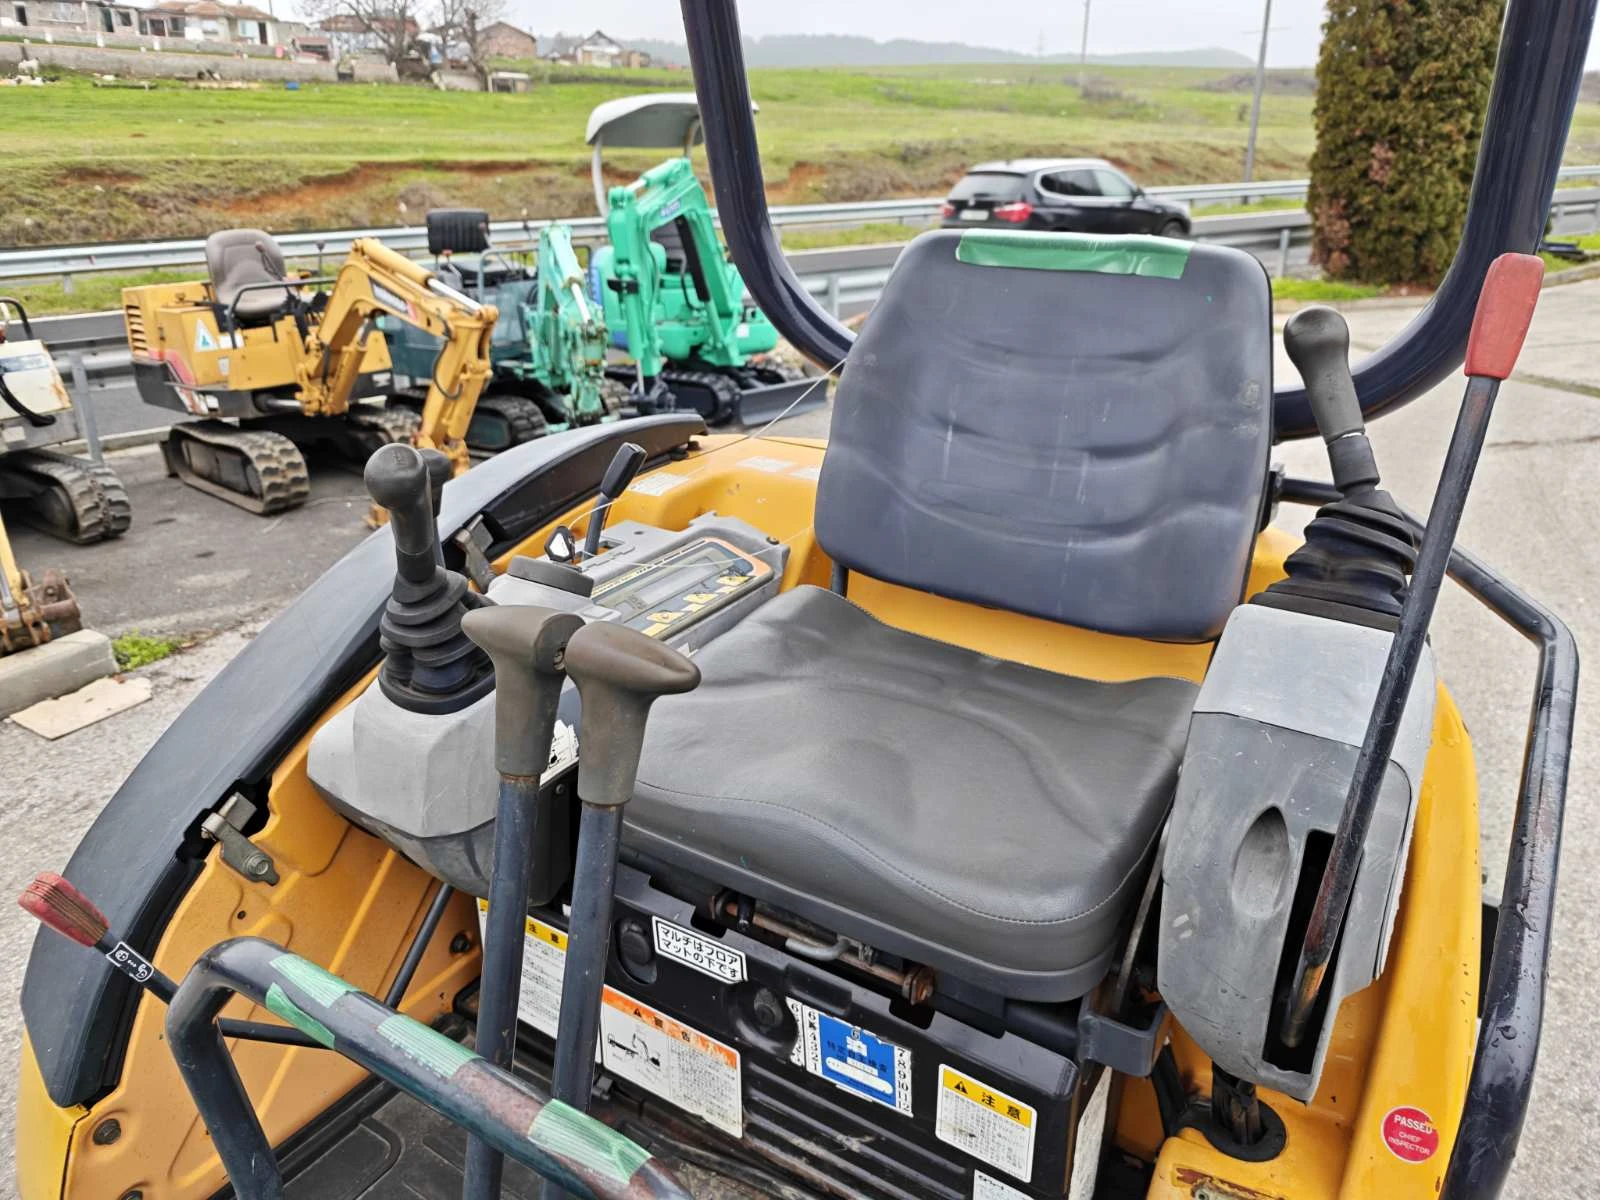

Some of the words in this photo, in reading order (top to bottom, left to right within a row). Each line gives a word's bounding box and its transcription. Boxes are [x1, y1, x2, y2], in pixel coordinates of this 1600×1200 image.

[660, 926, 738, 965] マルチはフロア
[662, 938, 738, 978] マットの下です
[981, 1091, 1022, 1121] 注意
[1394, 1114, 1433, 1135] PASSED
[1388, 1136, 1431, 1156] INSPECTOR
